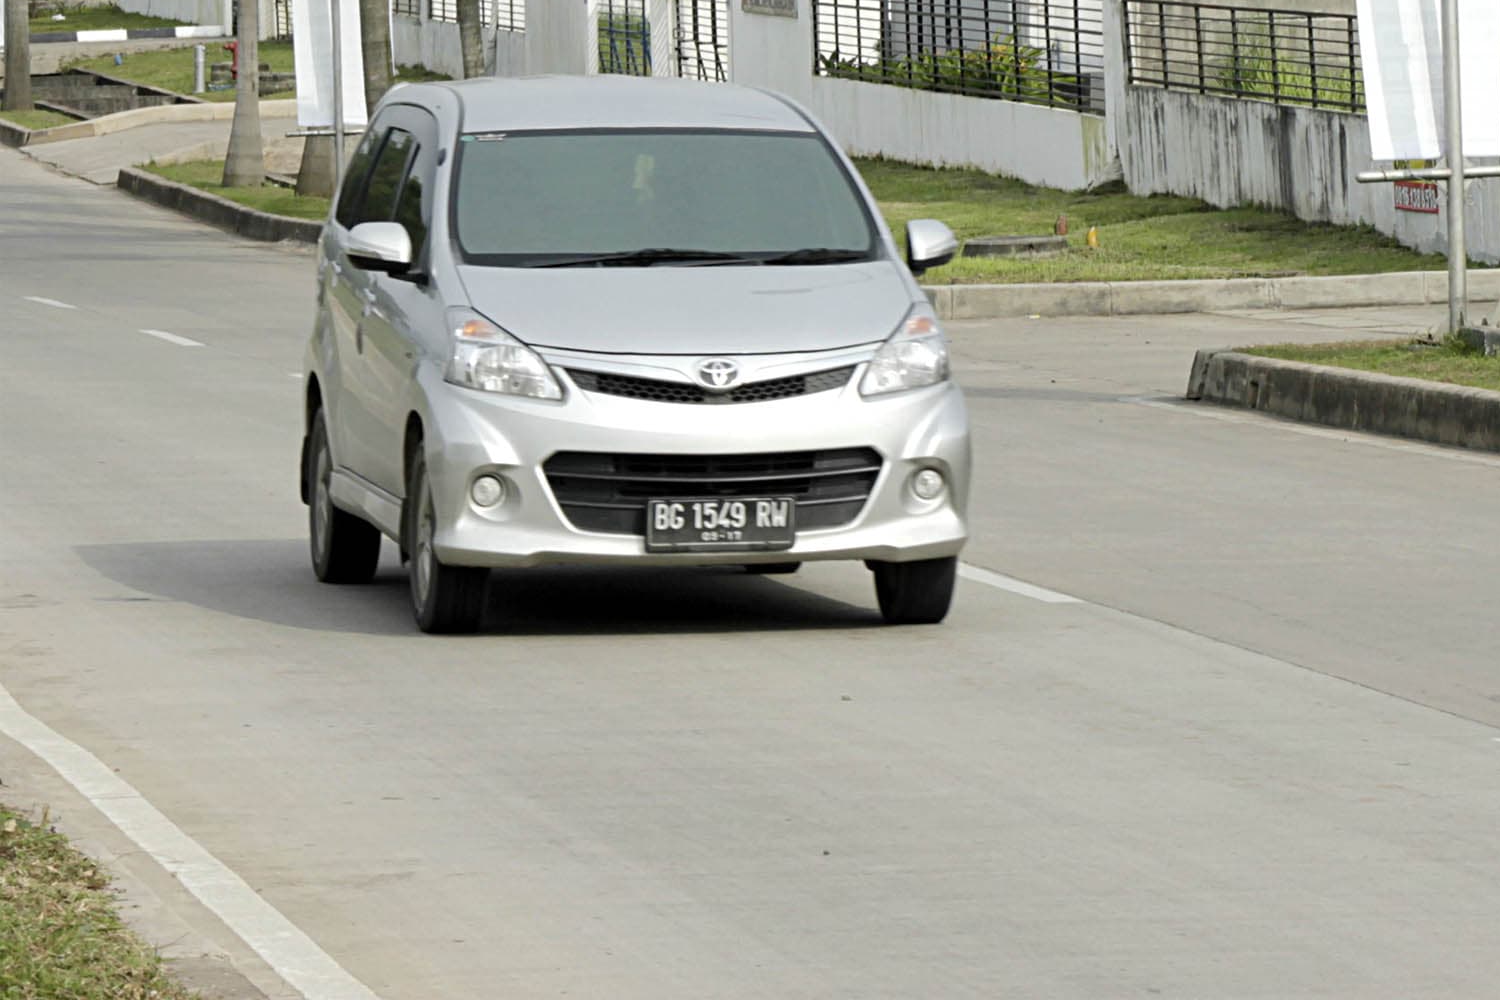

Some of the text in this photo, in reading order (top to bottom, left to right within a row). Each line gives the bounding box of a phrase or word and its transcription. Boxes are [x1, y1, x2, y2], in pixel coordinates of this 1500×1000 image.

[655, 501, 788, 530] BG 1549 RW
